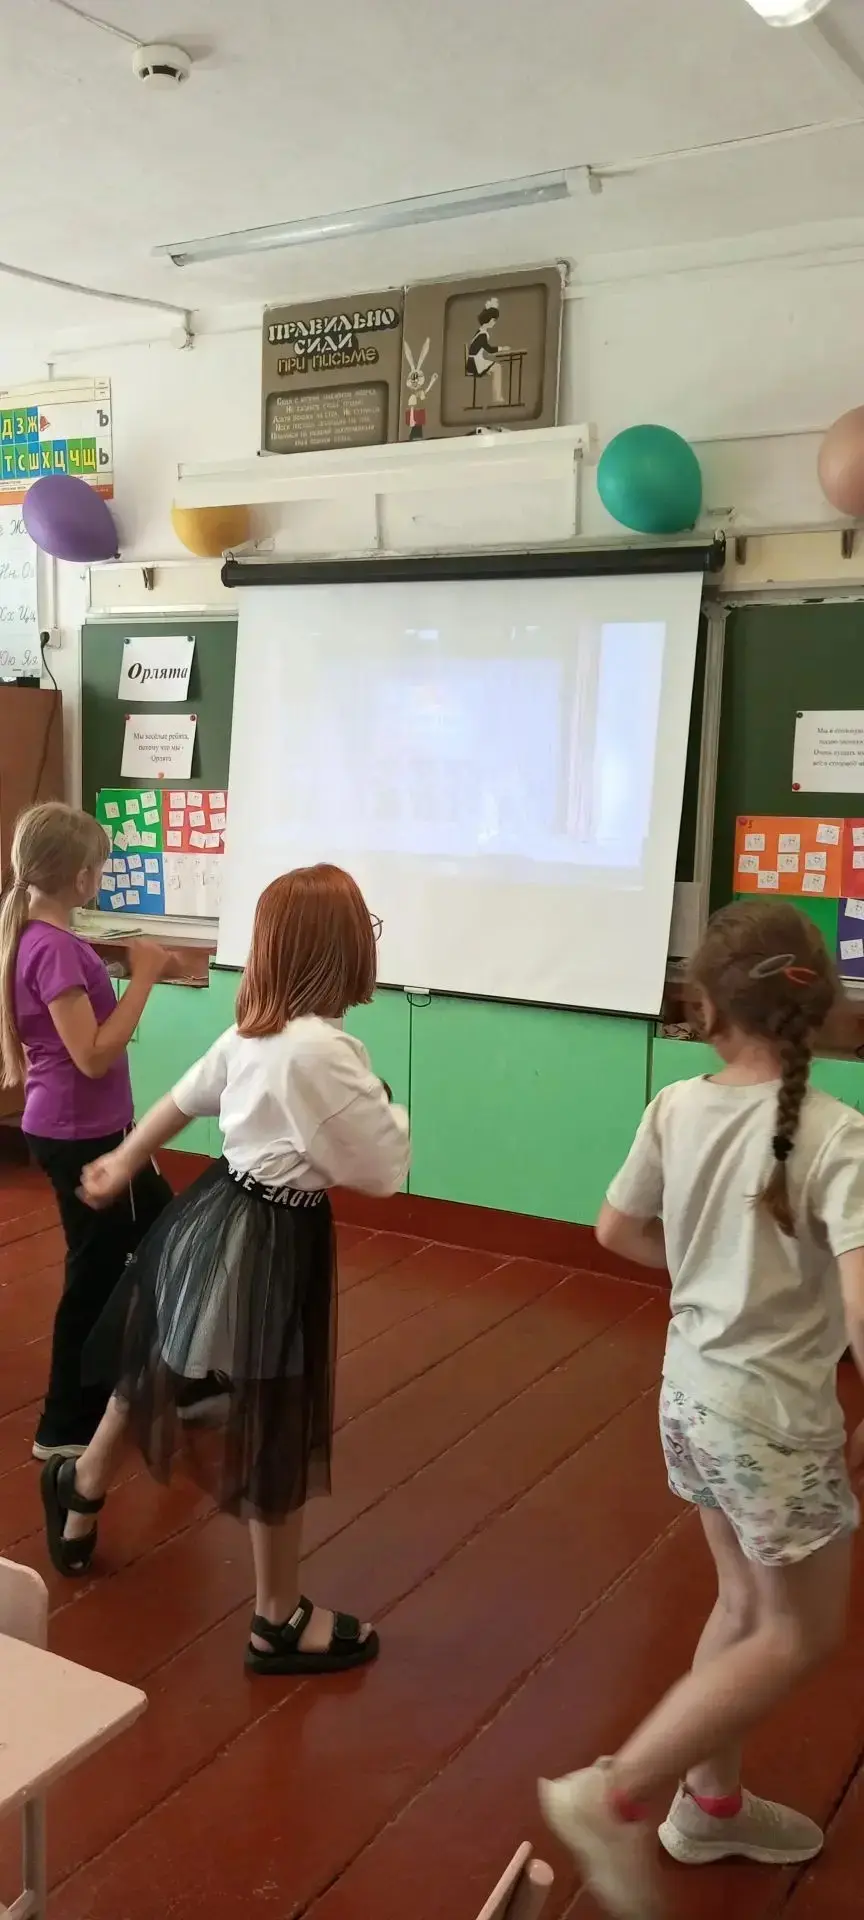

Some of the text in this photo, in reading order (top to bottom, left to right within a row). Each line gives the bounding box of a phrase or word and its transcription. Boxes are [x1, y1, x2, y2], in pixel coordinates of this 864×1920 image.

[267, 308, 395, 341] ПРАВИЛЬНО
[294, 332, 353, 355] СИДИ
[28, 416, 38, 433] Ж
[97, 409, 109, 427] Ъ
[4, 447, 109, 472] Т С Ш Х Ц Ч Щ Ь
[128, 662, 188, 683] Орлята
